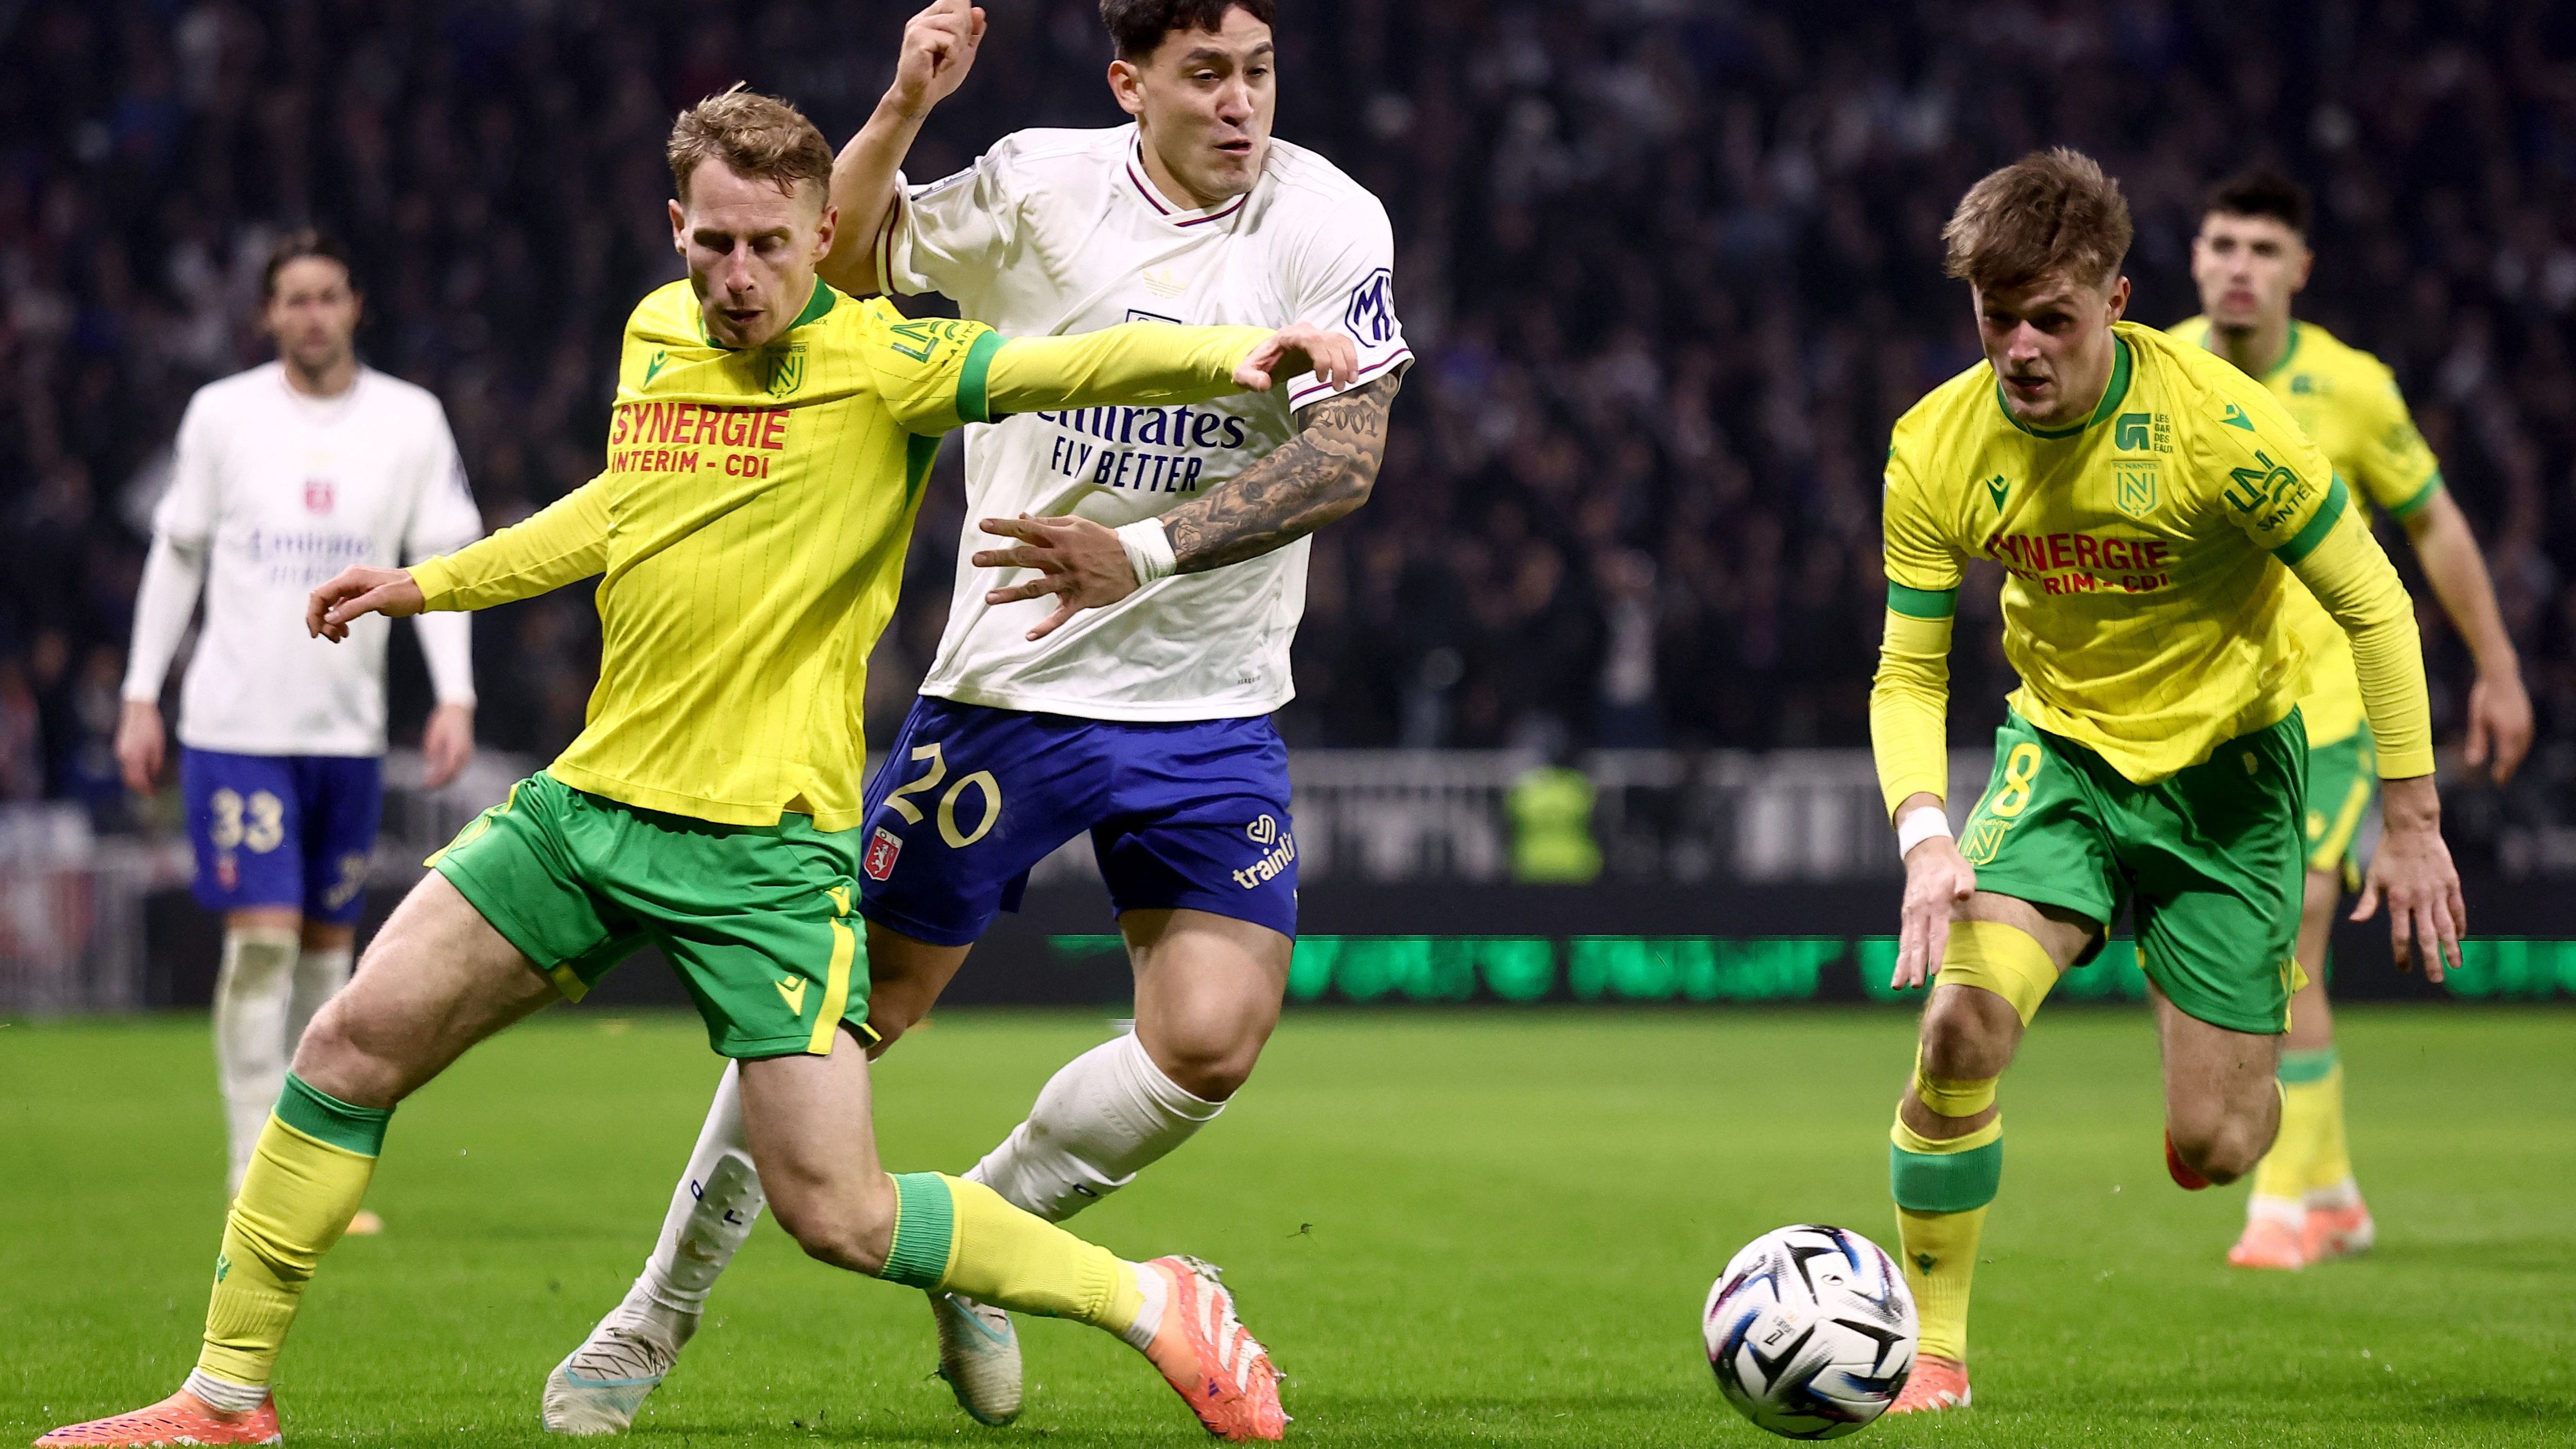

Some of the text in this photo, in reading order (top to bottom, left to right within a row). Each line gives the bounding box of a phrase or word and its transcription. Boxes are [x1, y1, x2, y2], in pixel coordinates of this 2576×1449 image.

[613, 402, 790, 450] SYNERGIE
[1037, 405, 1246, 449] mirates
[2154, 423, 2170, 433] GAR
[2154, 433, 2170, 443] DES
[2155, 413, 2169, 423] LES
[612, 450, 699, 474] INTERIM
[725, 454, 770, 479] CDI
[1051, 435, 1203, 493] FLY BETTER
[2154, 443, 2174, 454] EAUX
[2122, 573, 2170, 593] CDI
[882, 742, 1002, 849] 20
[1991, 742, 2042, 817] 8
[211, 787, 284, 854] 33
[1232, 832, 1296, 889] trainli
